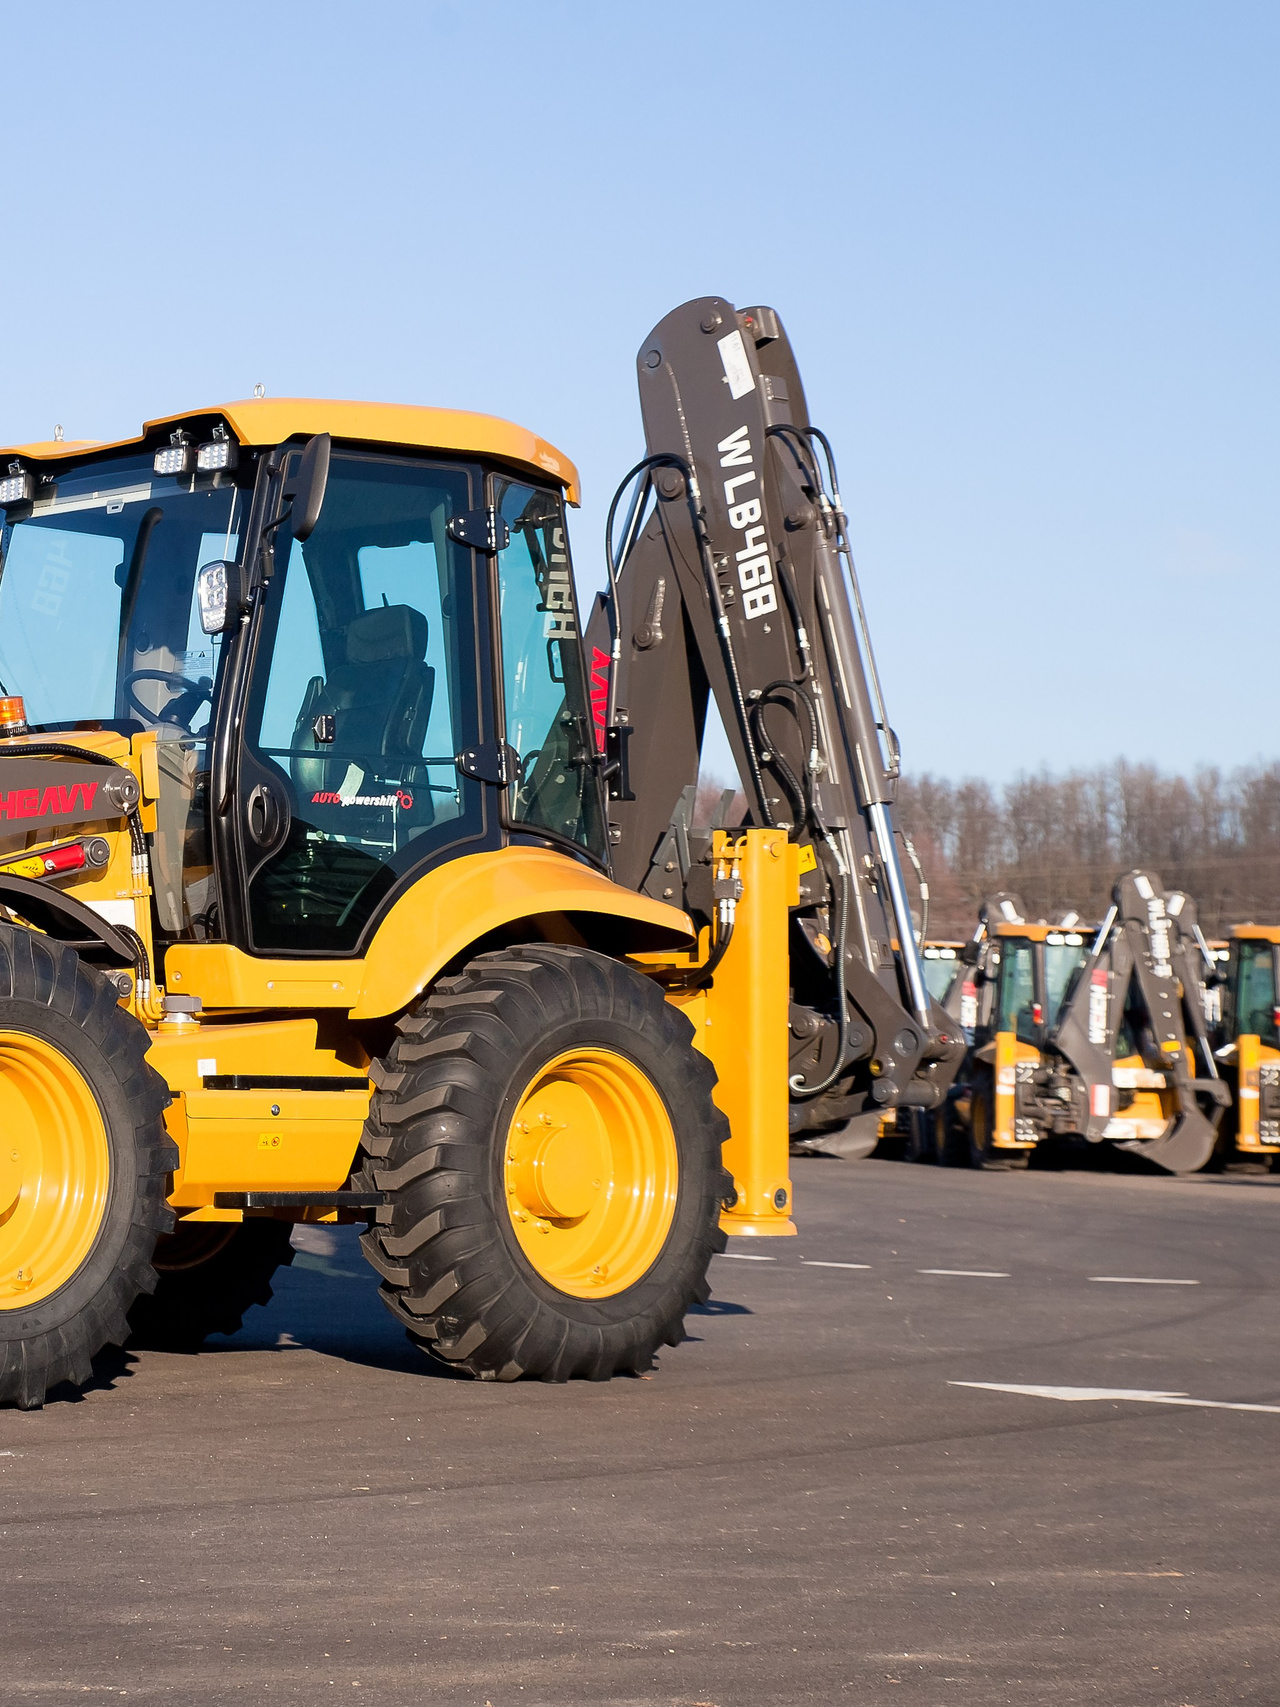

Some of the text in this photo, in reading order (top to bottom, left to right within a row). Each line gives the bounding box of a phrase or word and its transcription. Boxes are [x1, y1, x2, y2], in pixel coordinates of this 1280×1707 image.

[716, 424, 779, 619] WLB468
[311, 792, 398, 807] AUTO powershift
